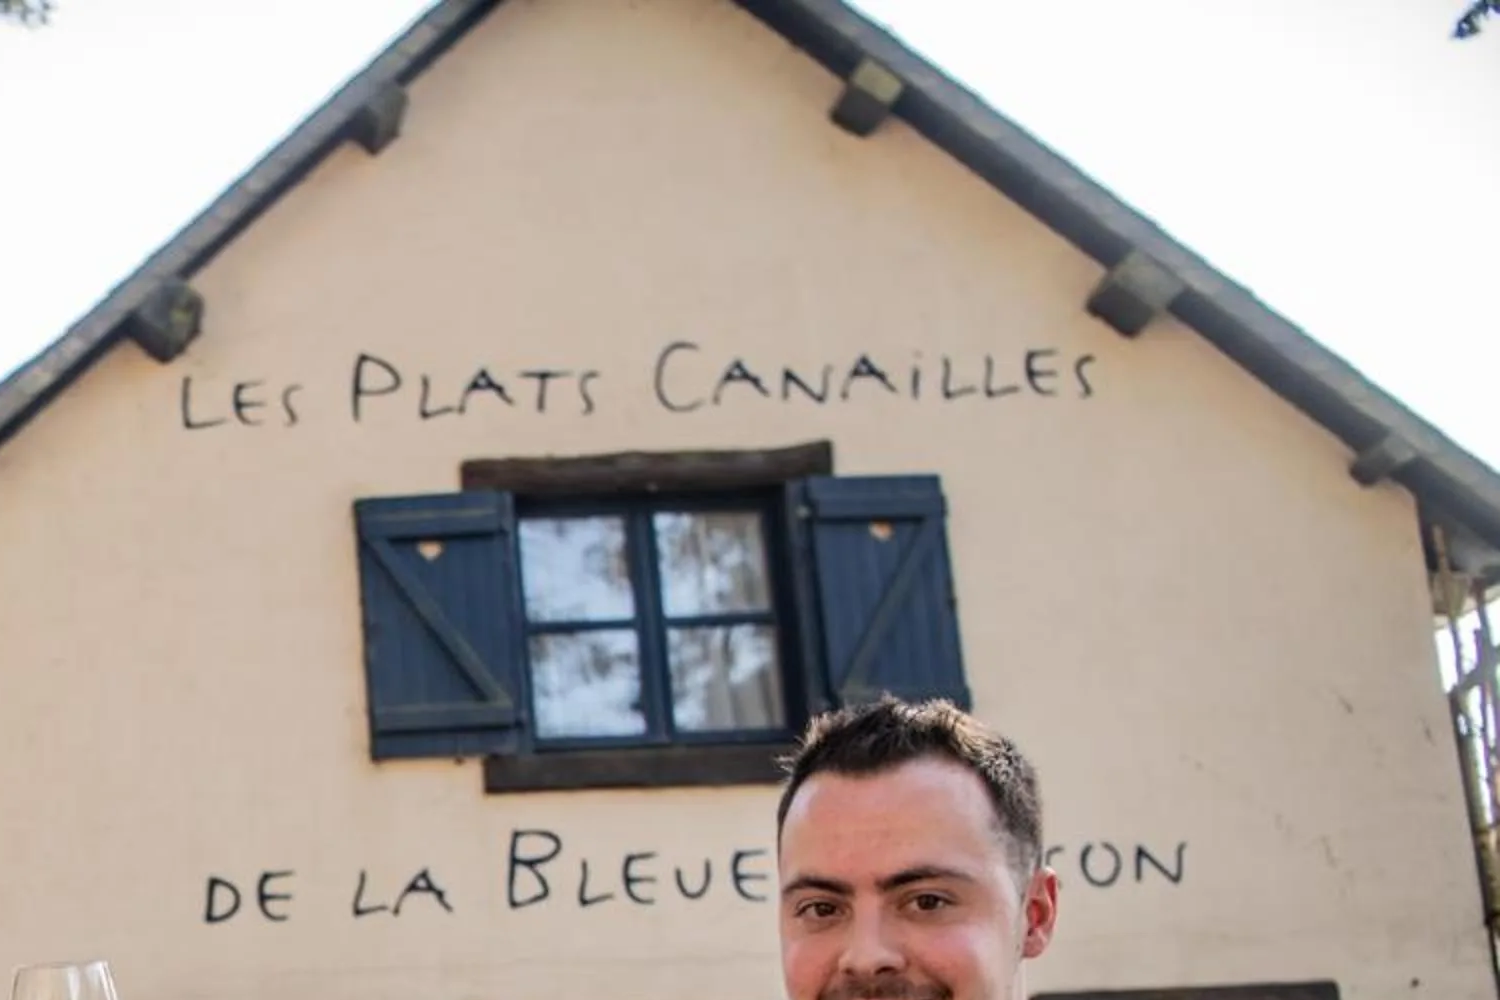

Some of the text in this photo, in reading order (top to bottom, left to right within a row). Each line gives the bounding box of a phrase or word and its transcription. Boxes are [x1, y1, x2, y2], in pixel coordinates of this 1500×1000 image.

[180, 374, 302, 431] LES
[350, 351, 602, 423] PLATS
[203, 870, 296, 926] DE
[351, 866, 454, 920] LA
[505, 828, 768, 912] BLEUE
